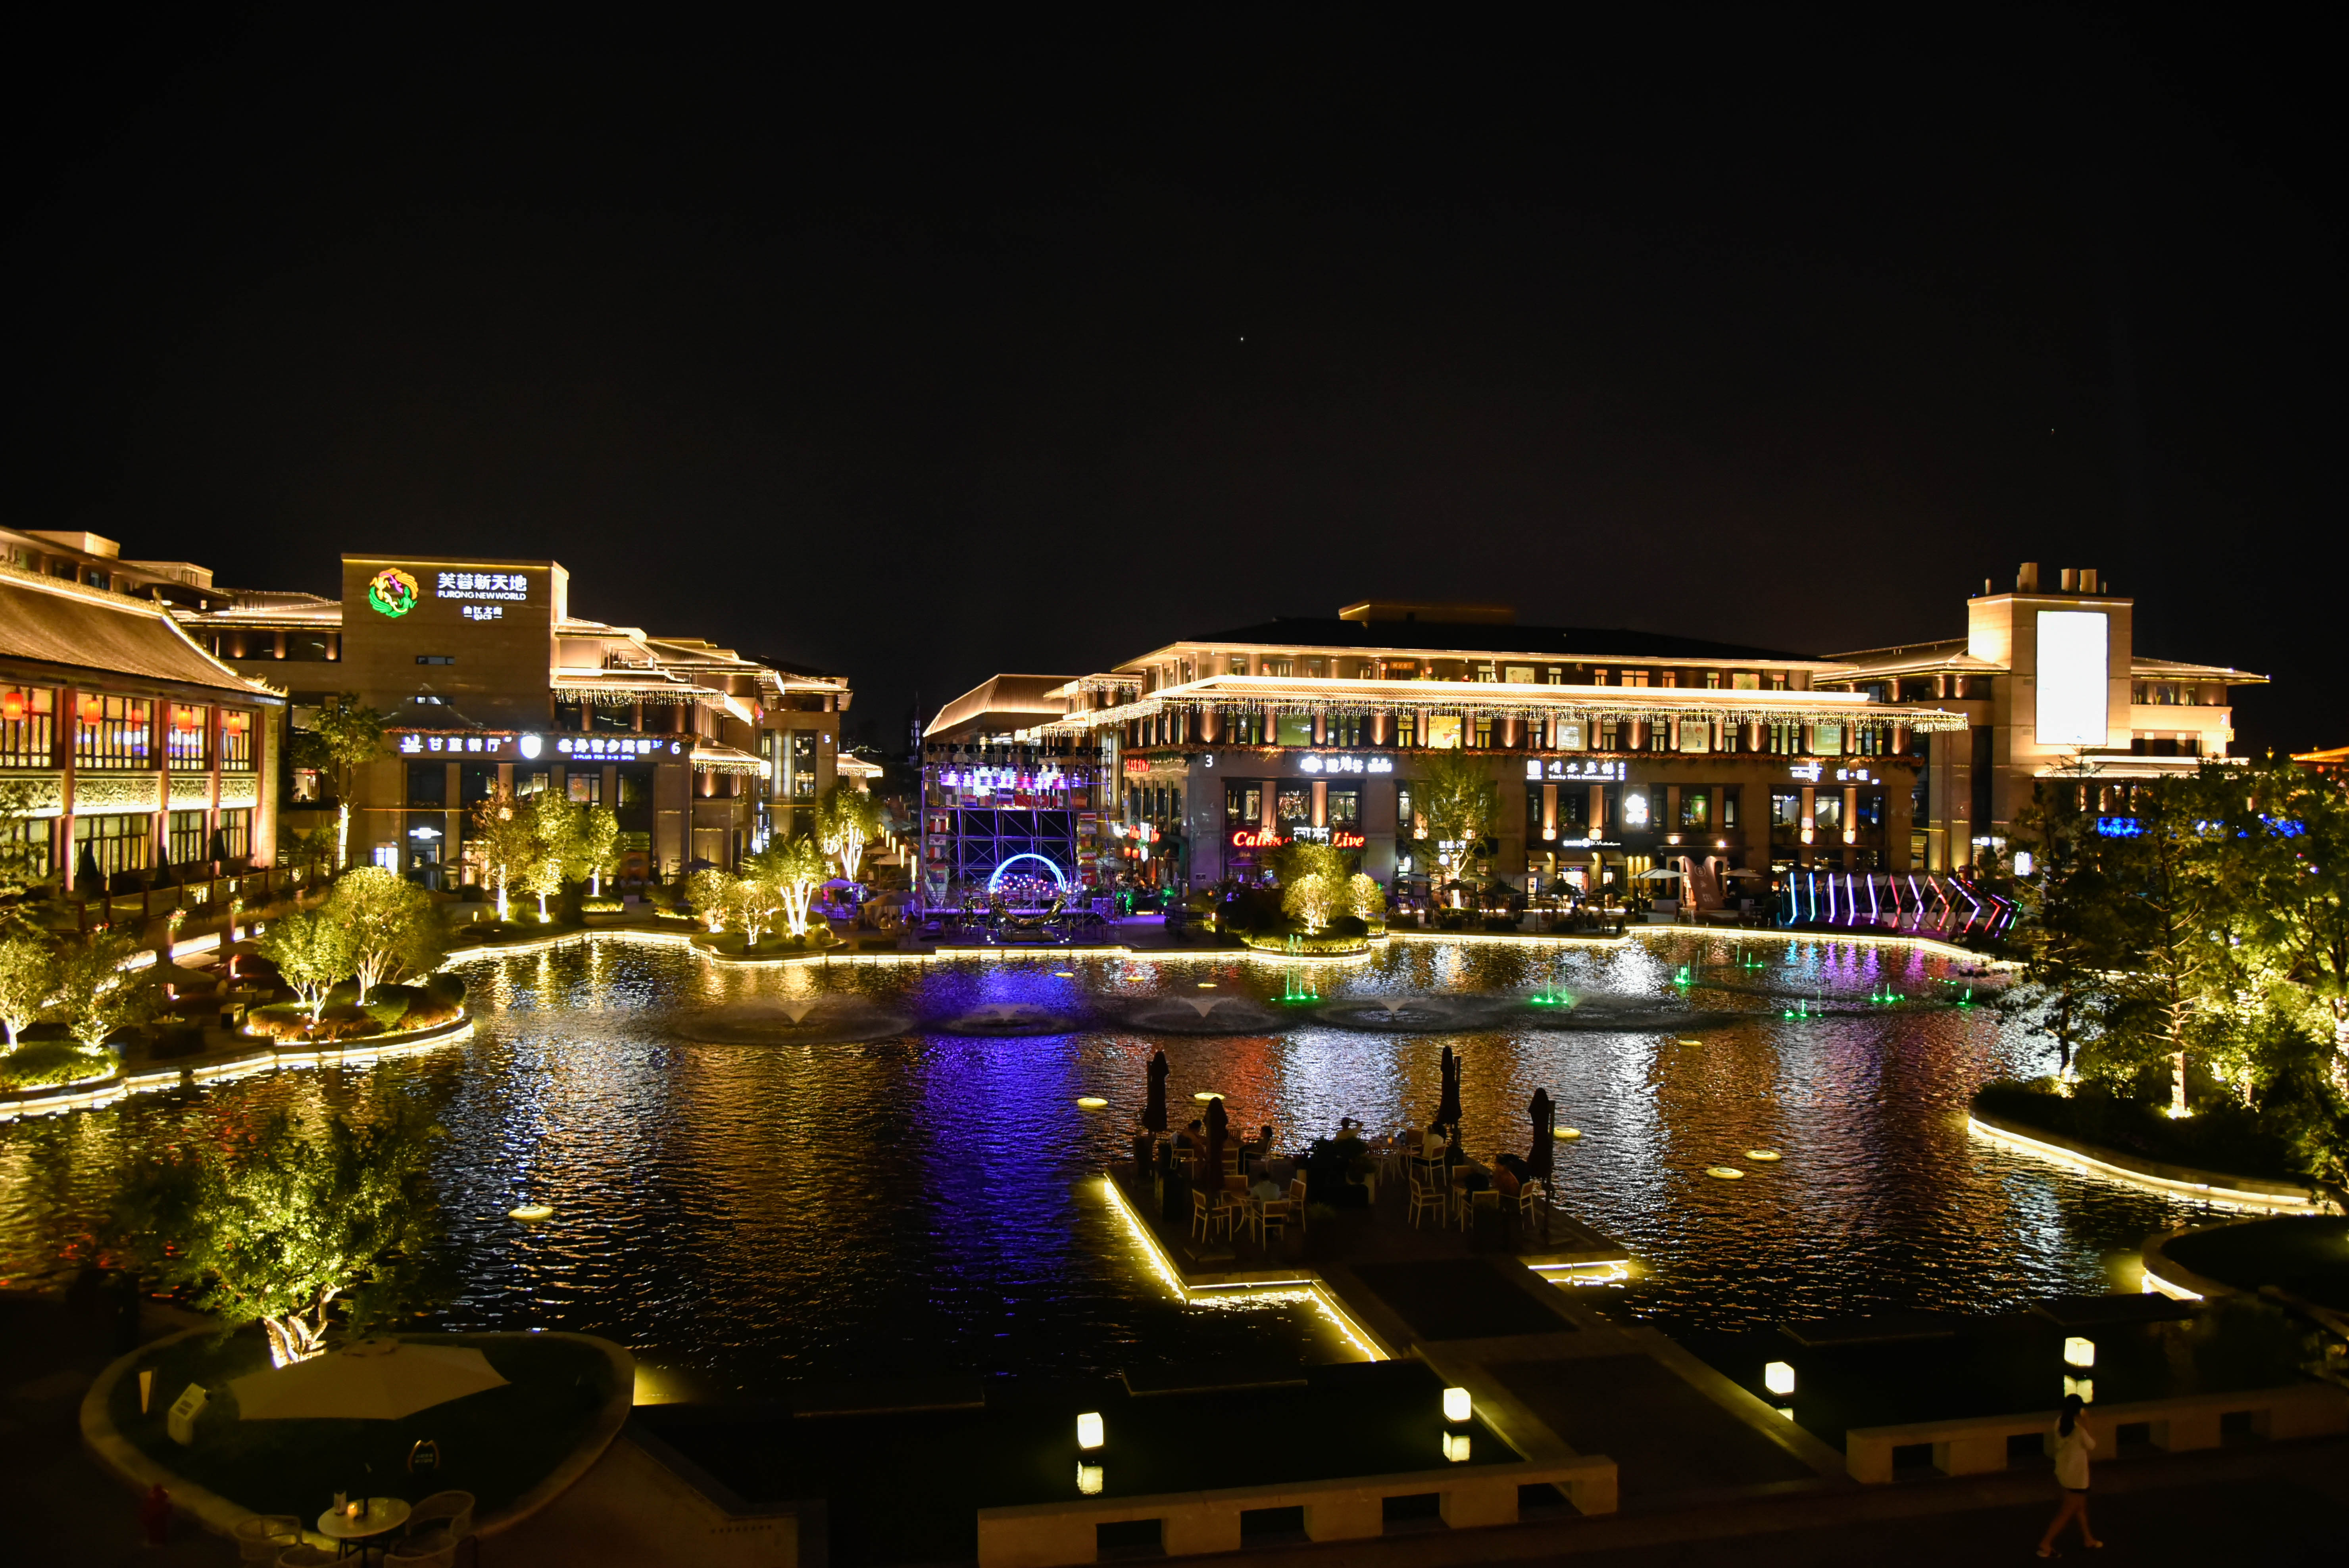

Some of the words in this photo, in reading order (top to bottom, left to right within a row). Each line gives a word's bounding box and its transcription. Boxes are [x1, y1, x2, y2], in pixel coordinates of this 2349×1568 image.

[438, 572, 527, 592] 芙蓉新天地
[438, 590, 475, 599] FURONG
[496, 592, 527, 600] WORLD
[2220, 714, 2226, 724] 2
[824, 734, 831, 744] 5
[671, 742, 681, 754] 6
[1205, 754, 1213, 768] 3
[1332, 832, 1365, 847] Live
